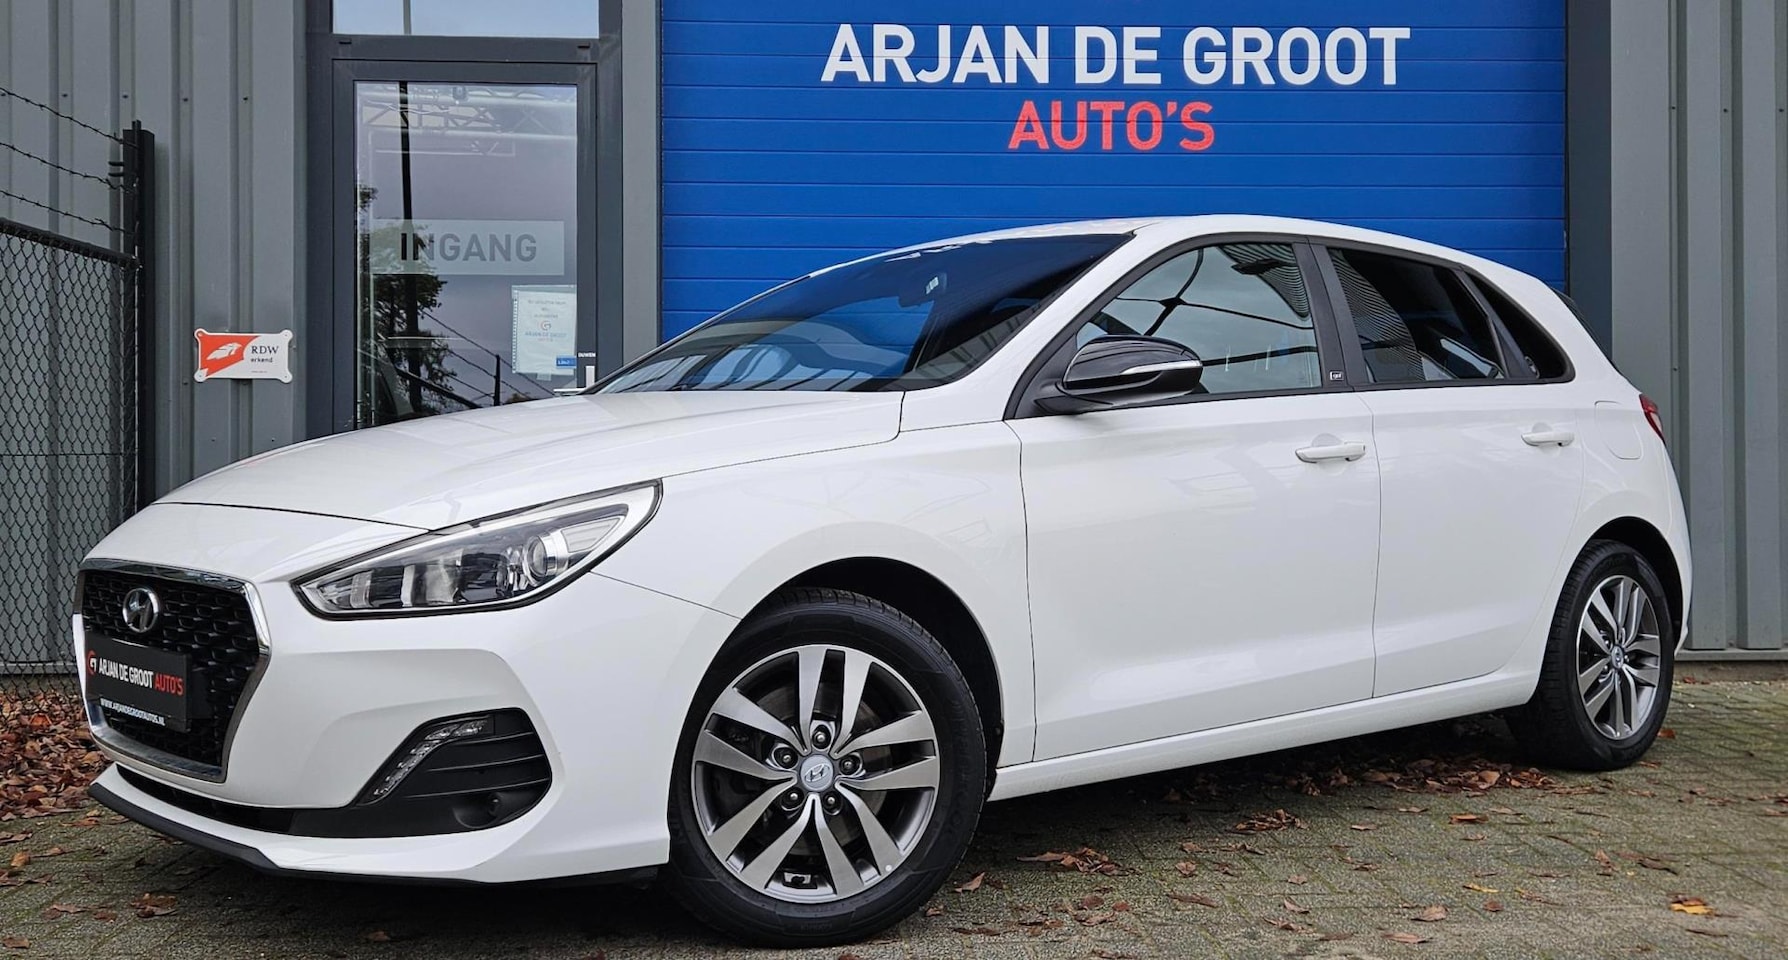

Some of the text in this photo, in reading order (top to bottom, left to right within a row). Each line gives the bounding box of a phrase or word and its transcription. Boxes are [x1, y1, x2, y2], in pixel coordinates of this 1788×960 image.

[821, 24, 1410, 86] ARJAN DE GROOT
[1008, 101, 1215, 151] AUTO'S
[400, 232, 537, 262] INGANG
[251, 345, 279, 354] RDW
[98, 657, 184, 696] ARJAN DE GROOT AUTO'S
